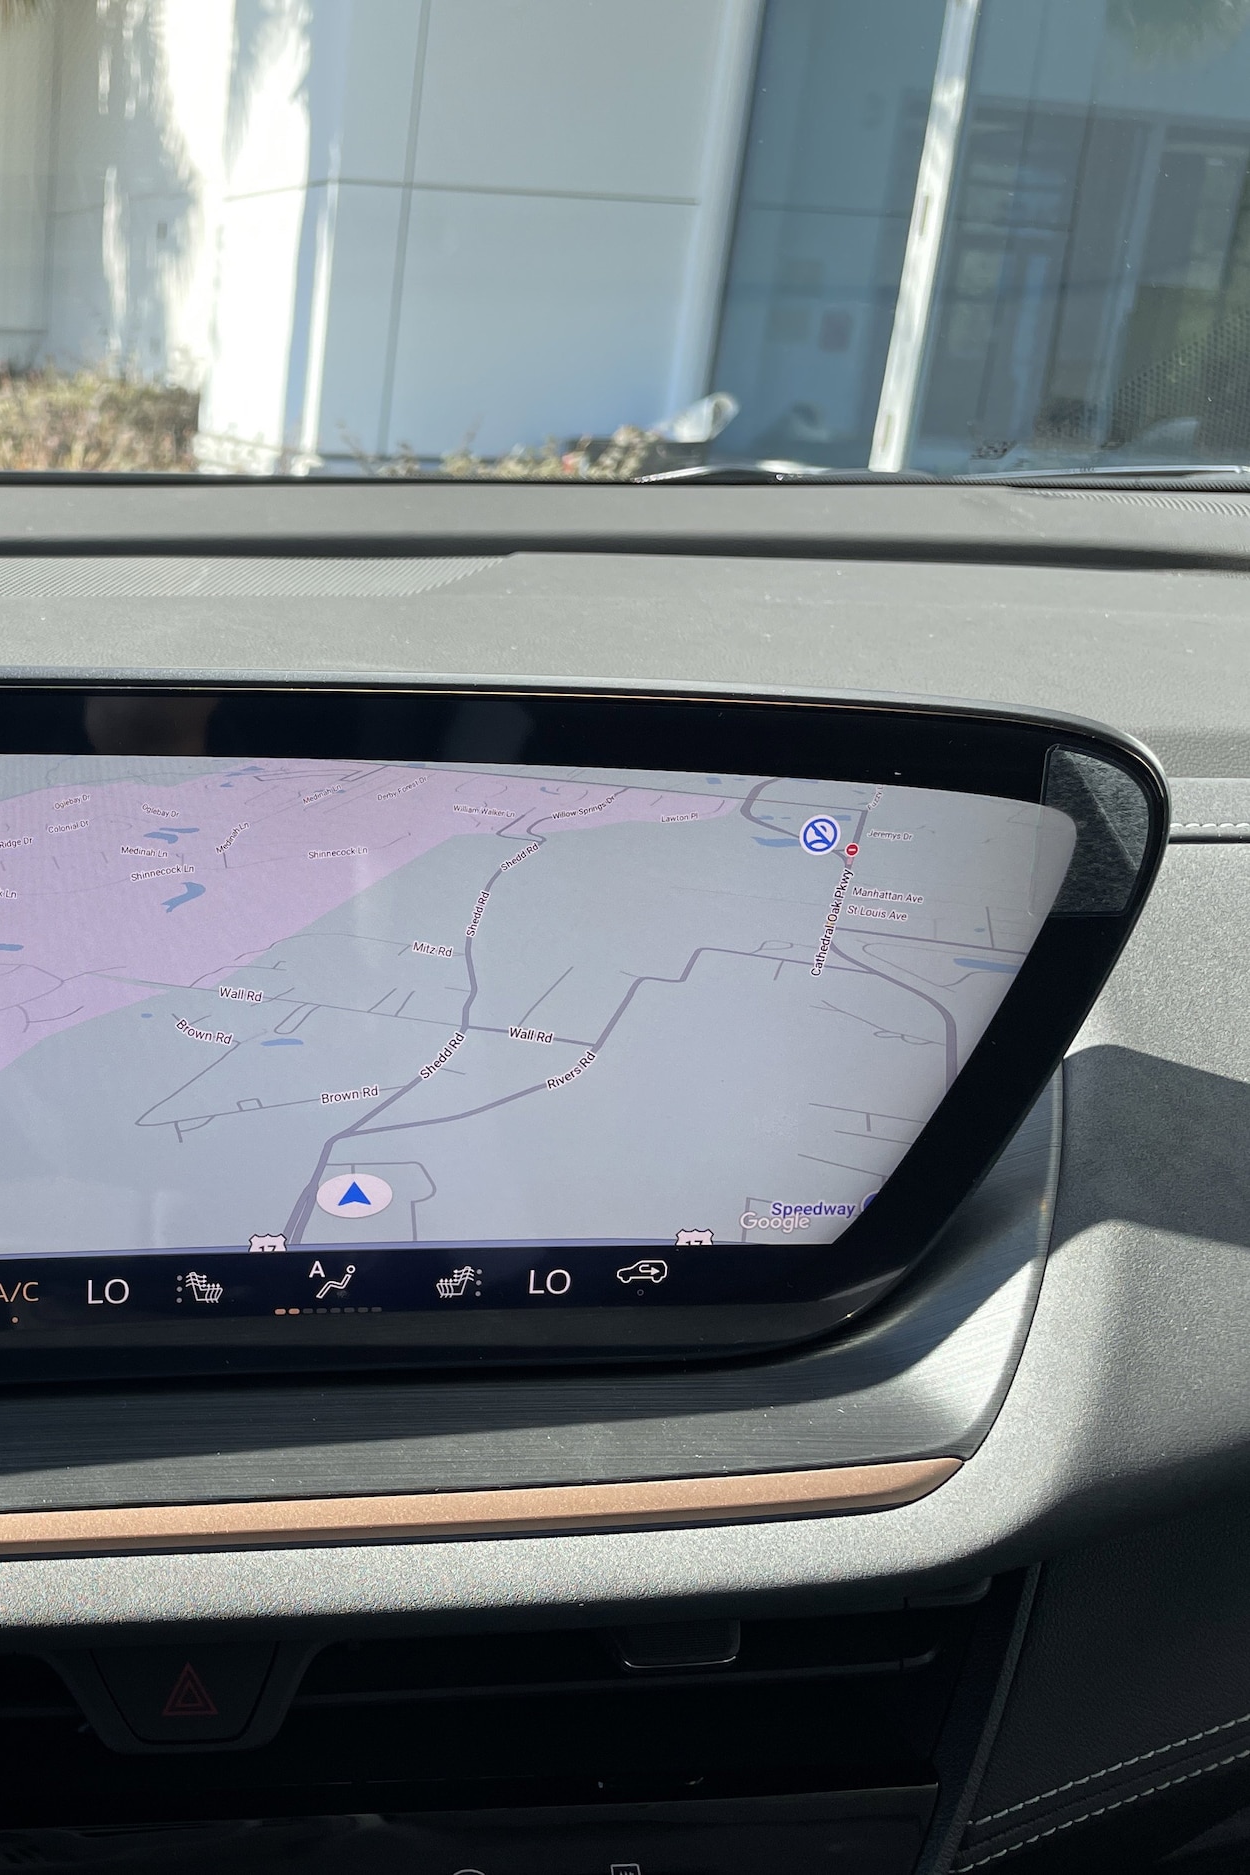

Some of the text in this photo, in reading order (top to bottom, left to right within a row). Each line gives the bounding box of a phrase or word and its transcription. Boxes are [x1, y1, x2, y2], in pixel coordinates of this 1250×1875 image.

[82, 794, 91, 802] Dr
[170, 810, 180, 818] Dr
[453, 804, 515, 818] William Walker Ln
[552, 795, 615, 820] Willow Springs Dr
[48, 819, 89, 834] Colonial Dr
[661, 814, 688, 823] Lawton
[215, 821, 250, 854] Medinah Ln
[869, 830, 913, 841] Jeremys Dr
[0, 839, 22, 853] Ridge
[23, 837, 33, 846] Dr
[121, 846, 168, 858] Medinah Ln
[308, 846, 368, 860] Shinnecock Ln
[500, 843, 539, 871] Shedd Rd
[130, 864, 195, 882] Shinnecock Ln
[5, 889, 17, 899] Ln
[853, 886, 924, 903] Manhattan Ave
[466, 891, 490, 937] Shedd Rd
[847, 904, 908, 921] St Louis Ave
[811, 868, 854, 977] Cathedral Oak Pkwy
[412, 942, 453, 957] Mitz Rd
[219, 987, 263, 1003] Wall Rd
[176, 1018, 233, 1046] Brown Rd
[508, 1026, 553, 1045] Wall Rd
[419, 1032, 466, 1081] Shedd Rd
[547, 1050, 597, 1090] Rivers Rd
[321, 1086, 379, 1104] Brown Rd
[771, 1201, 856, 1220] Speedway
[740, 1211, 810, 1234] Google
[308, 1260, 326, 1278] A
[528, 1268, 572, 1295] LO
[87, 1278, 130, 1305] LO
